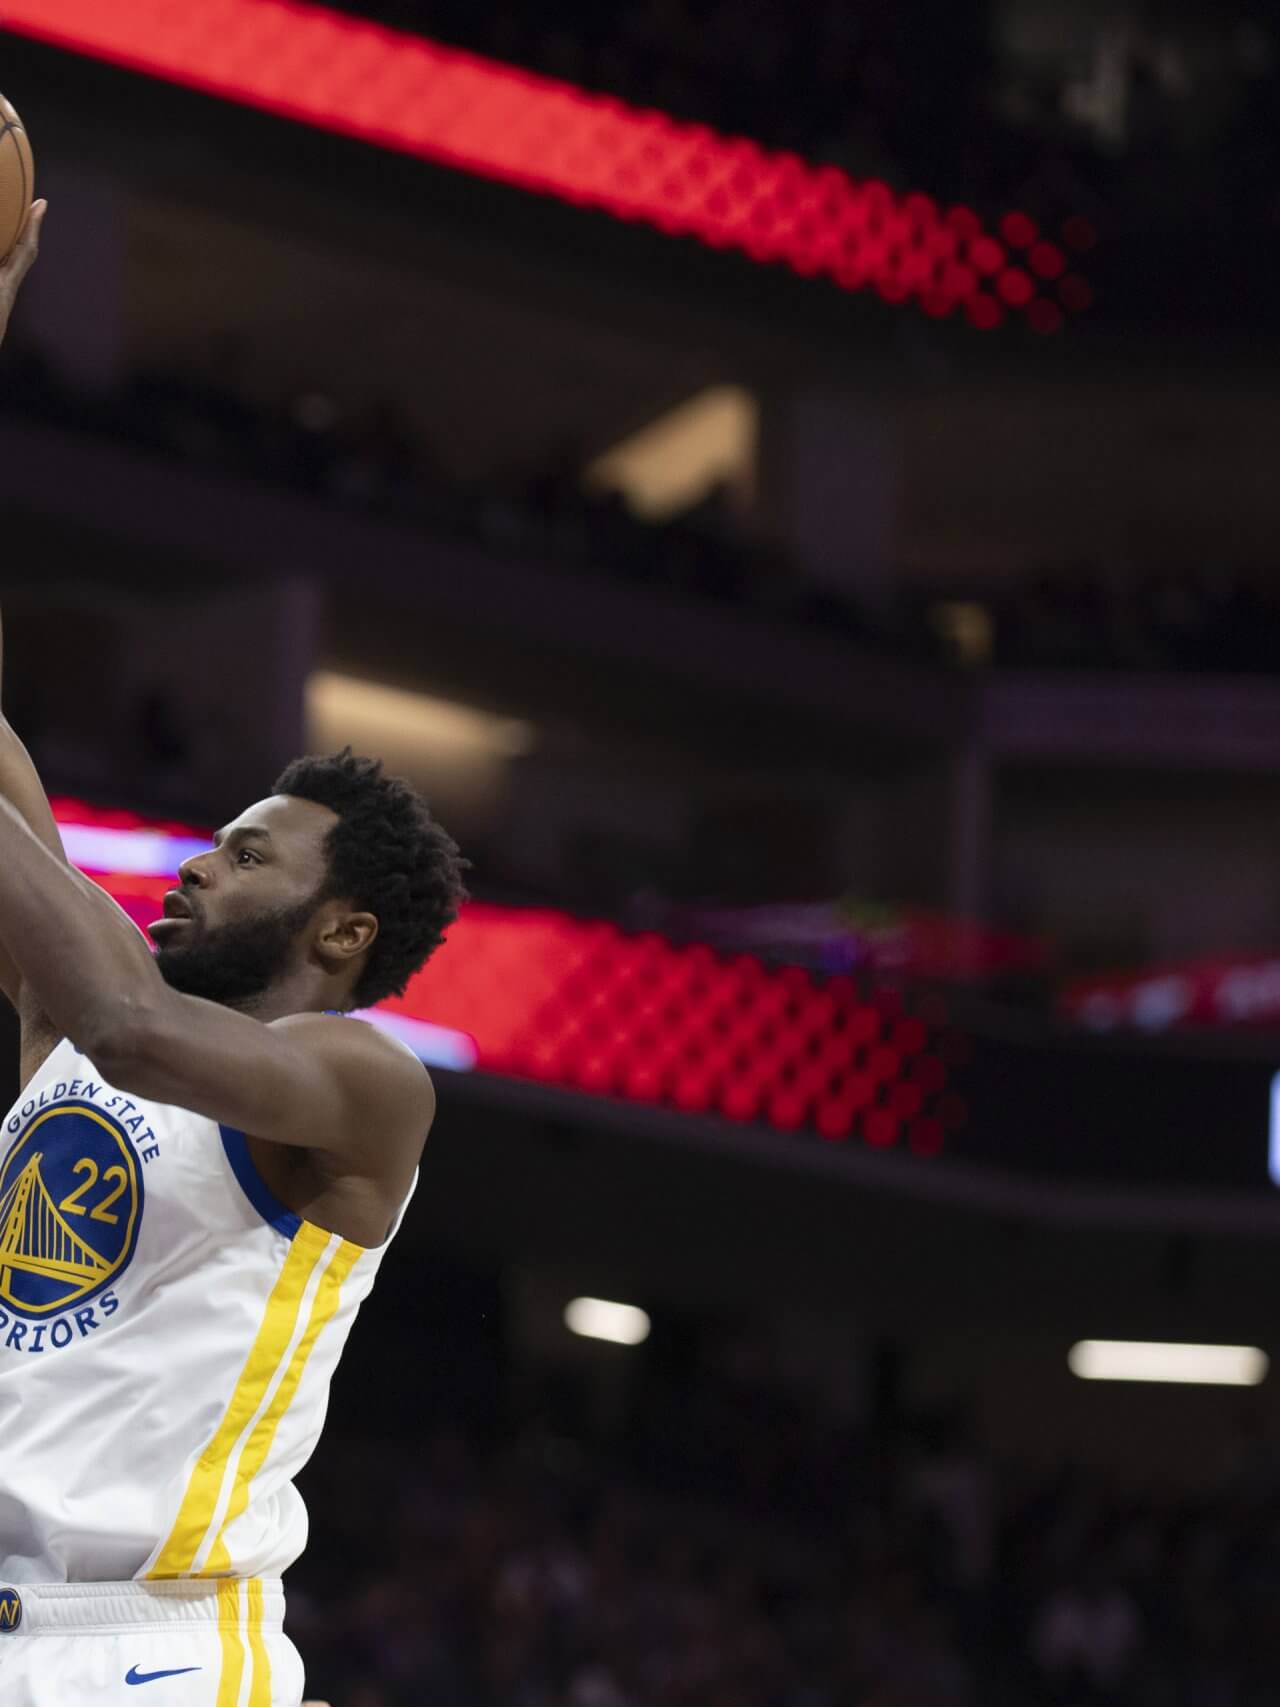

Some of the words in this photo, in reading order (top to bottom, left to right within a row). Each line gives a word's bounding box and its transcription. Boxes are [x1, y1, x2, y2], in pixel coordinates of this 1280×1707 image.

[6, 1079, 102, 1134] GOLDEN
[104, 1095, 161, 1165] STATE
[58, 1157, 129, 1225] 22
